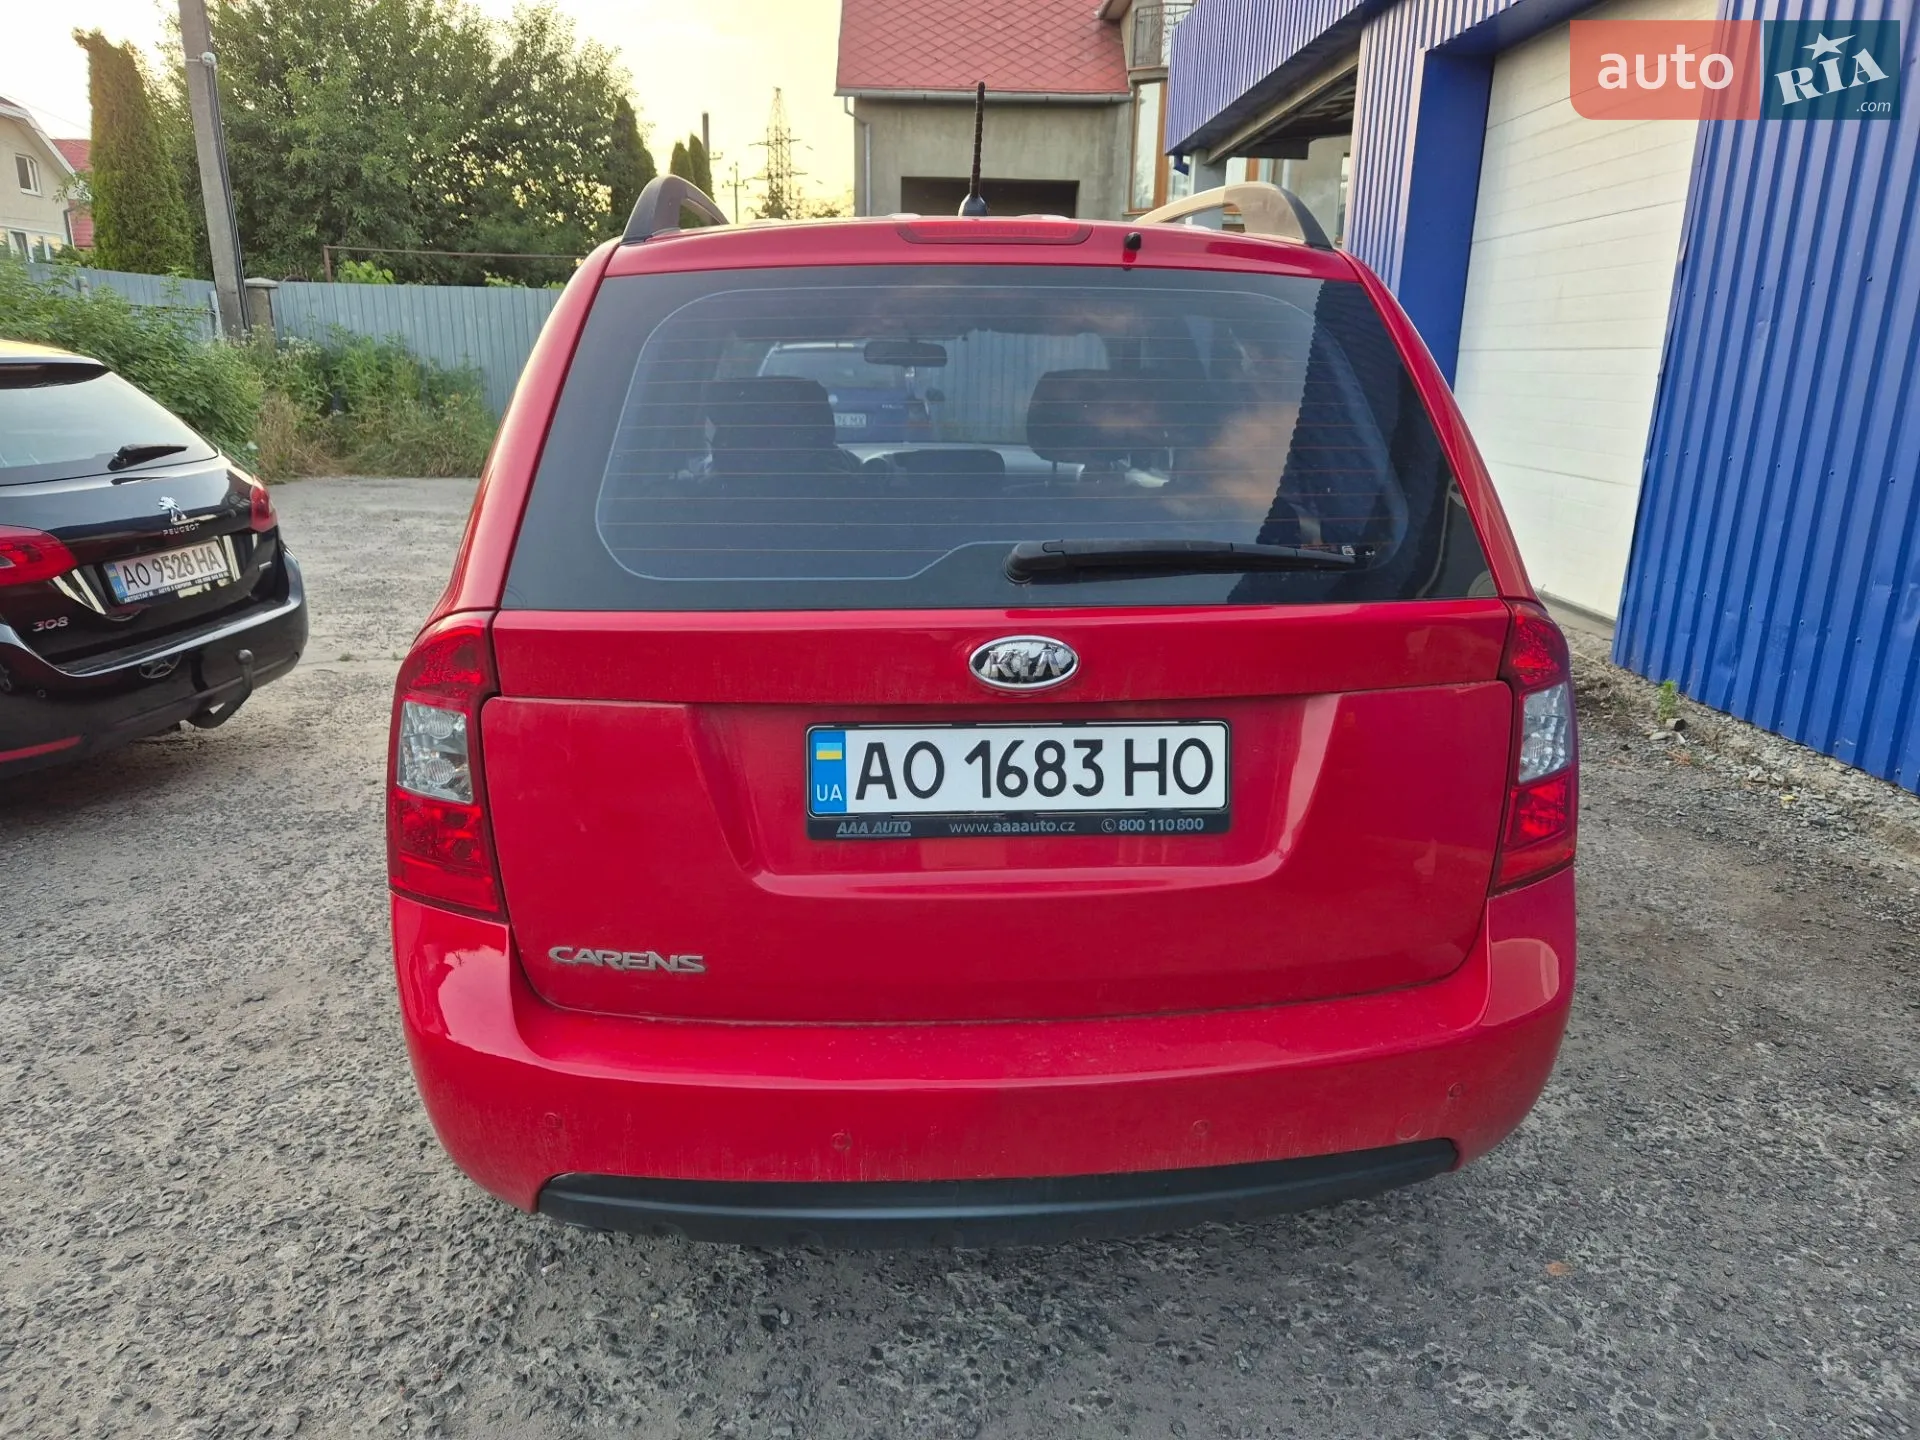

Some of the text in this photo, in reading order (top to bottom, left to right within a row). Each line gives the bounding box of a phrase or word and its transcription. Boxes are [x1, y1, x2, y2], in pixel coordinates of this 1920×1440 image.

[162, 523, 200, 536] PEUGEOT
[122, 562, 151, 591] AO
[152, 551, 195, 584] 9528
[192, 546, 222, 573] HA
[32, 616, 69, 632] 308
[989, 649, 1061, 678] KIA
[855, 737, 1214, 800] AO 1683 HO
[816, 784, 843, 802] UA
[836, 821, 912, 834] AAA AUTO
[949, 819, 1076, 833] www.aaaauto.cz
[1118, 818, 1204, 832] 800 110 800
[548, 946, 707, 974] CARENS
